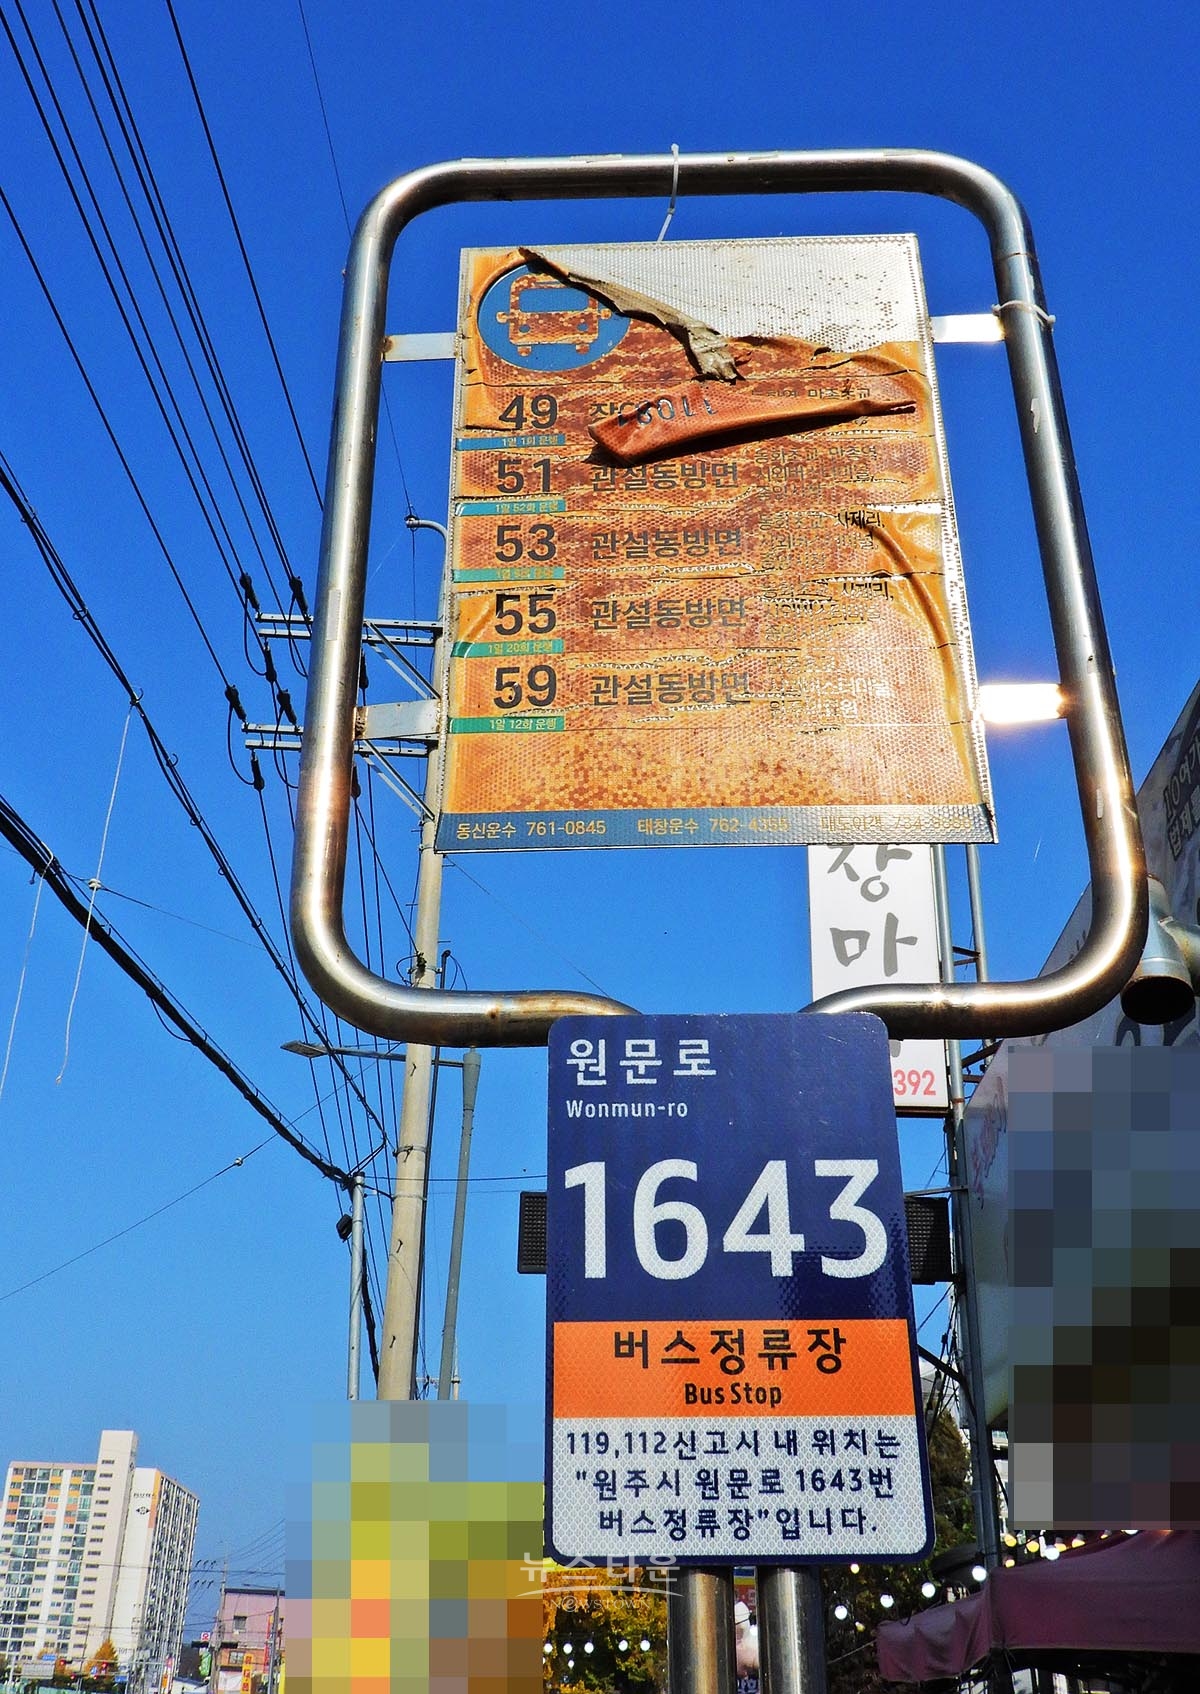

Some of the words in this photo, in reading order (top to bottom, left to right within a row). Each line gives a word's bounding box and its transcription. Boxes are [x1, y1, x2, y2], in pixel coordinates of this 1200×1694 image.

[498, 394, 558, 430] 49
[497, 458, 552, 494] 51
[591, 462, 738, 492] 관설동방면
[495, 523, 556, 562] 53
[592, 529, 742, 559] 관설동방면
[494, 593, 556, 635] 55
[591, 599, 747, 629] 관설동방면
[493, 665, 557, 709] 59
[590, 671, 751, 705] 관설동방면
[489, 720, 505, 730] 1일
[510, 719, 532, 730] 12회
[456, 823, 516, 839] 동신운수
[526, 820, 606, 836] 761-0845
[637, 818, 698, 835] 태창운수
[566, 1038, 717, 1086] 원문로
[566, 1100, 688, 1118] Wonmun-ro
[564, 1158, 888, 1280] 1643
[614, 1328, 847, 1375] 버스정류장
[684, 1384, 725, 1405] Bus
[730, 1383, 782, 1408] Stop
[812, 1429, 900, 1458] 위치는
